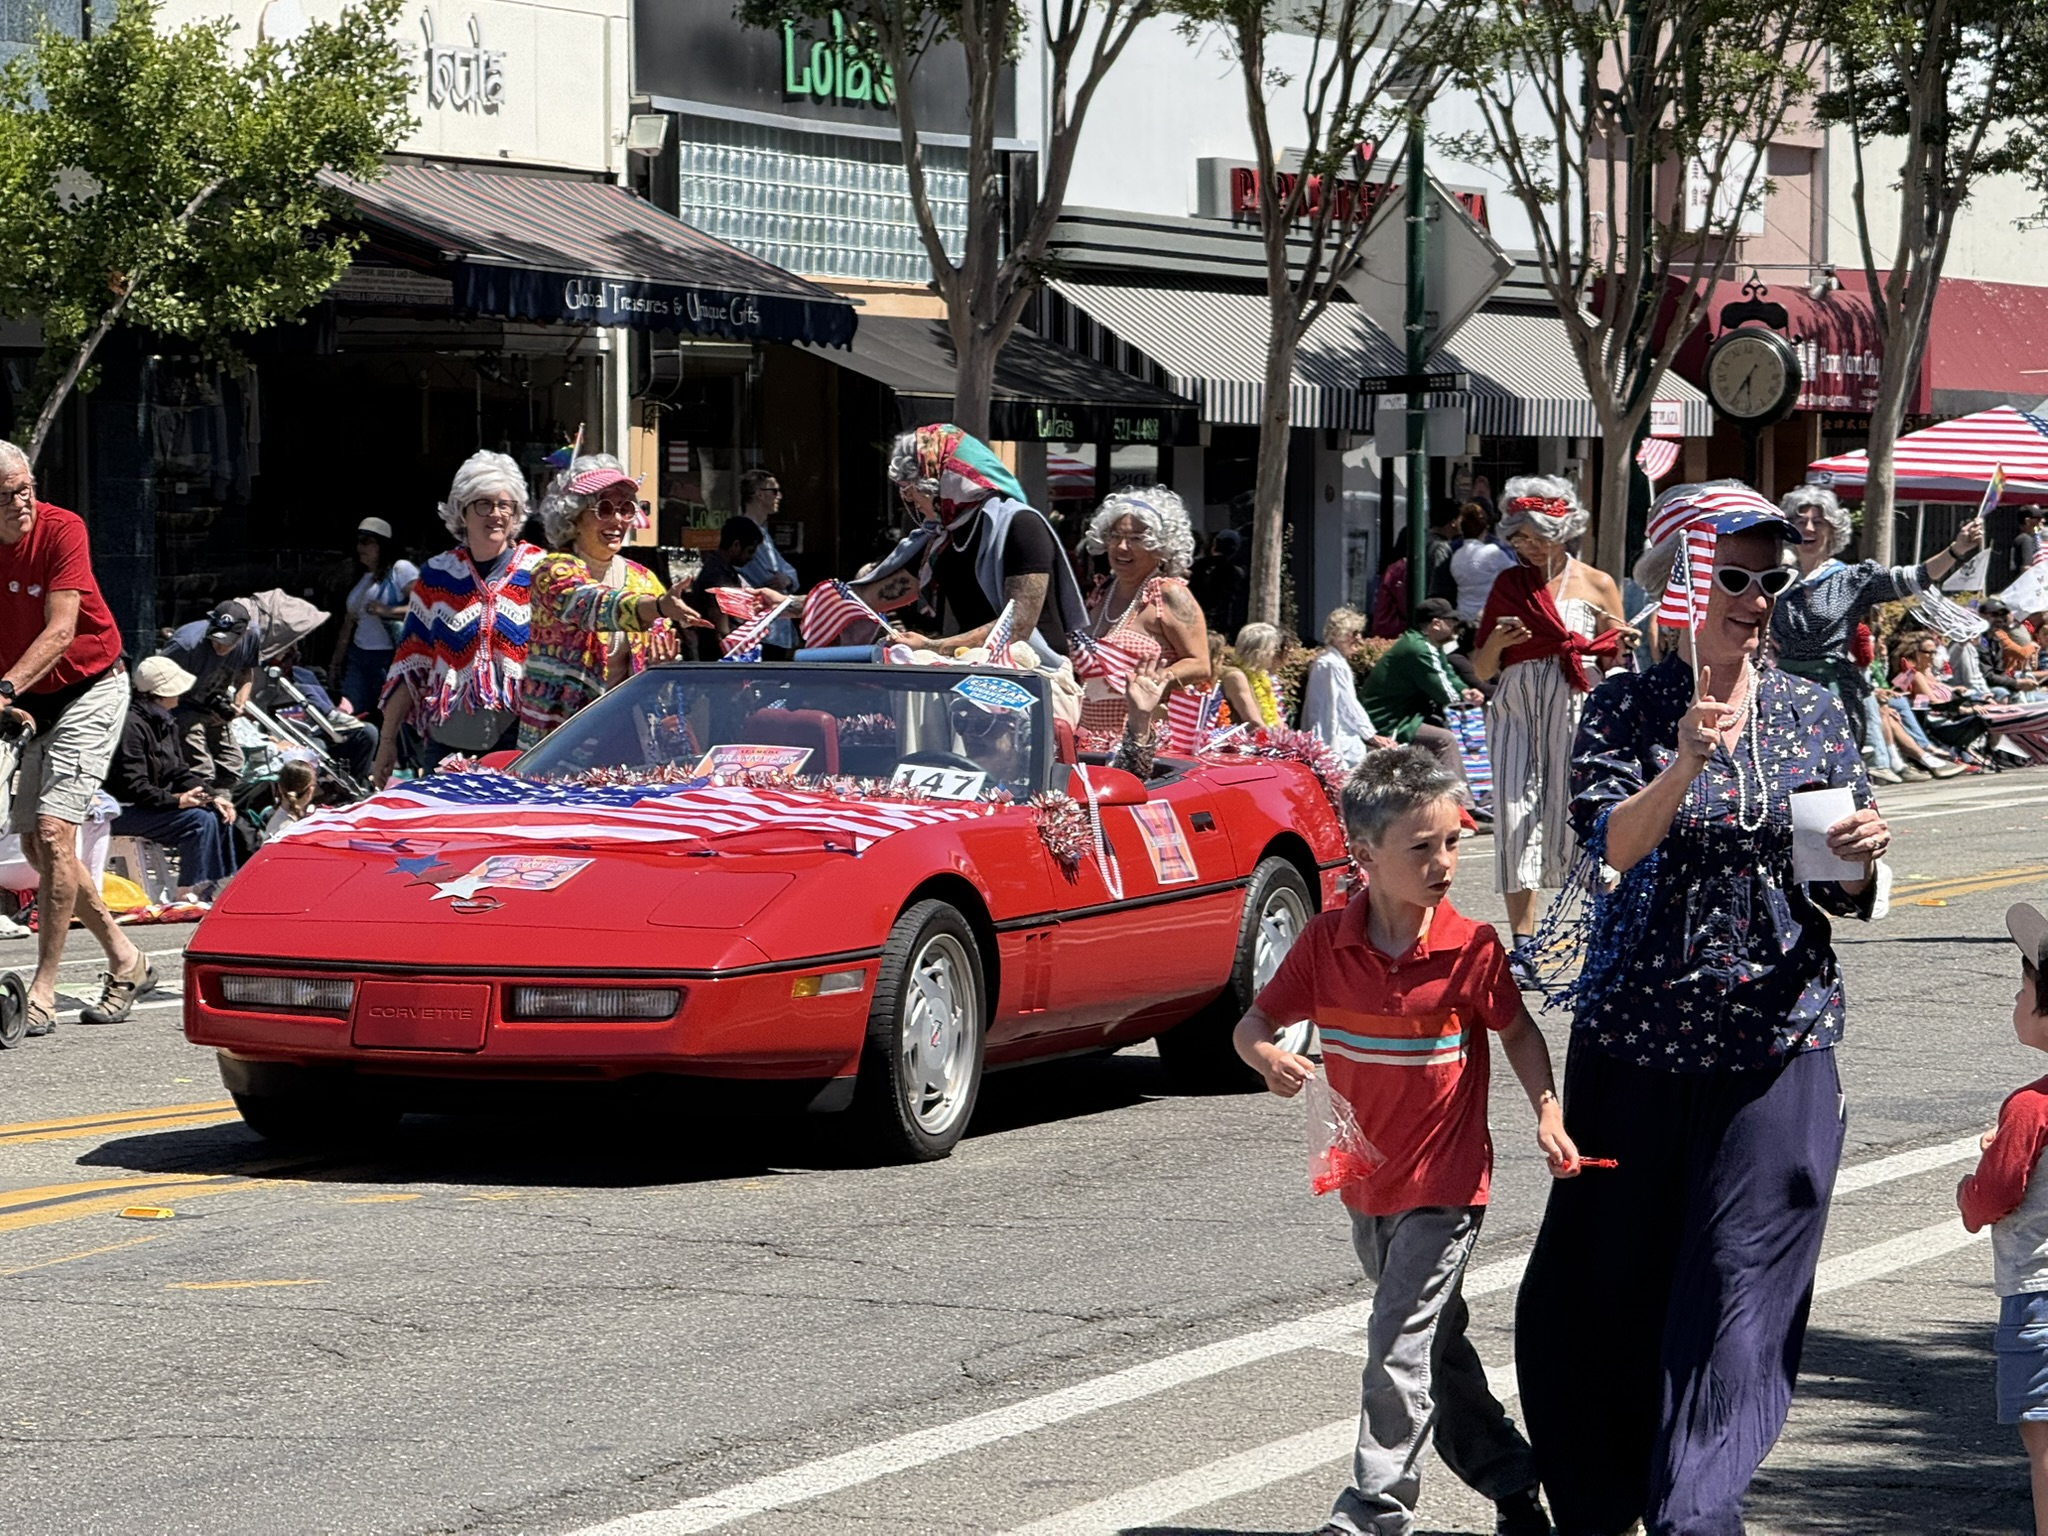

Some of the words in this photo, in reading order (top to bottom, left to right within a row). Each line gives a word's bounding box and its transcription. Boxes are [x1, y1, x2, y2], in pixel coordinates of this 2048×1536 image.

[565, 279, 607, 310] Global
[609, 284, 669, 314] Treasures
[673, 297, 683, 315] &
[687, 292, 728, 328] Unique
[730, 296, 761, 326] Gifts
[1036, 407, 1074, 438] Lola's
[965, 685, 1018, 705] ADVANTAGE
[968, 692, 1004, 705] DEALER
[901, 769, 977, 797] 147
[368, 1007, 473, 1020] CORVETTE
